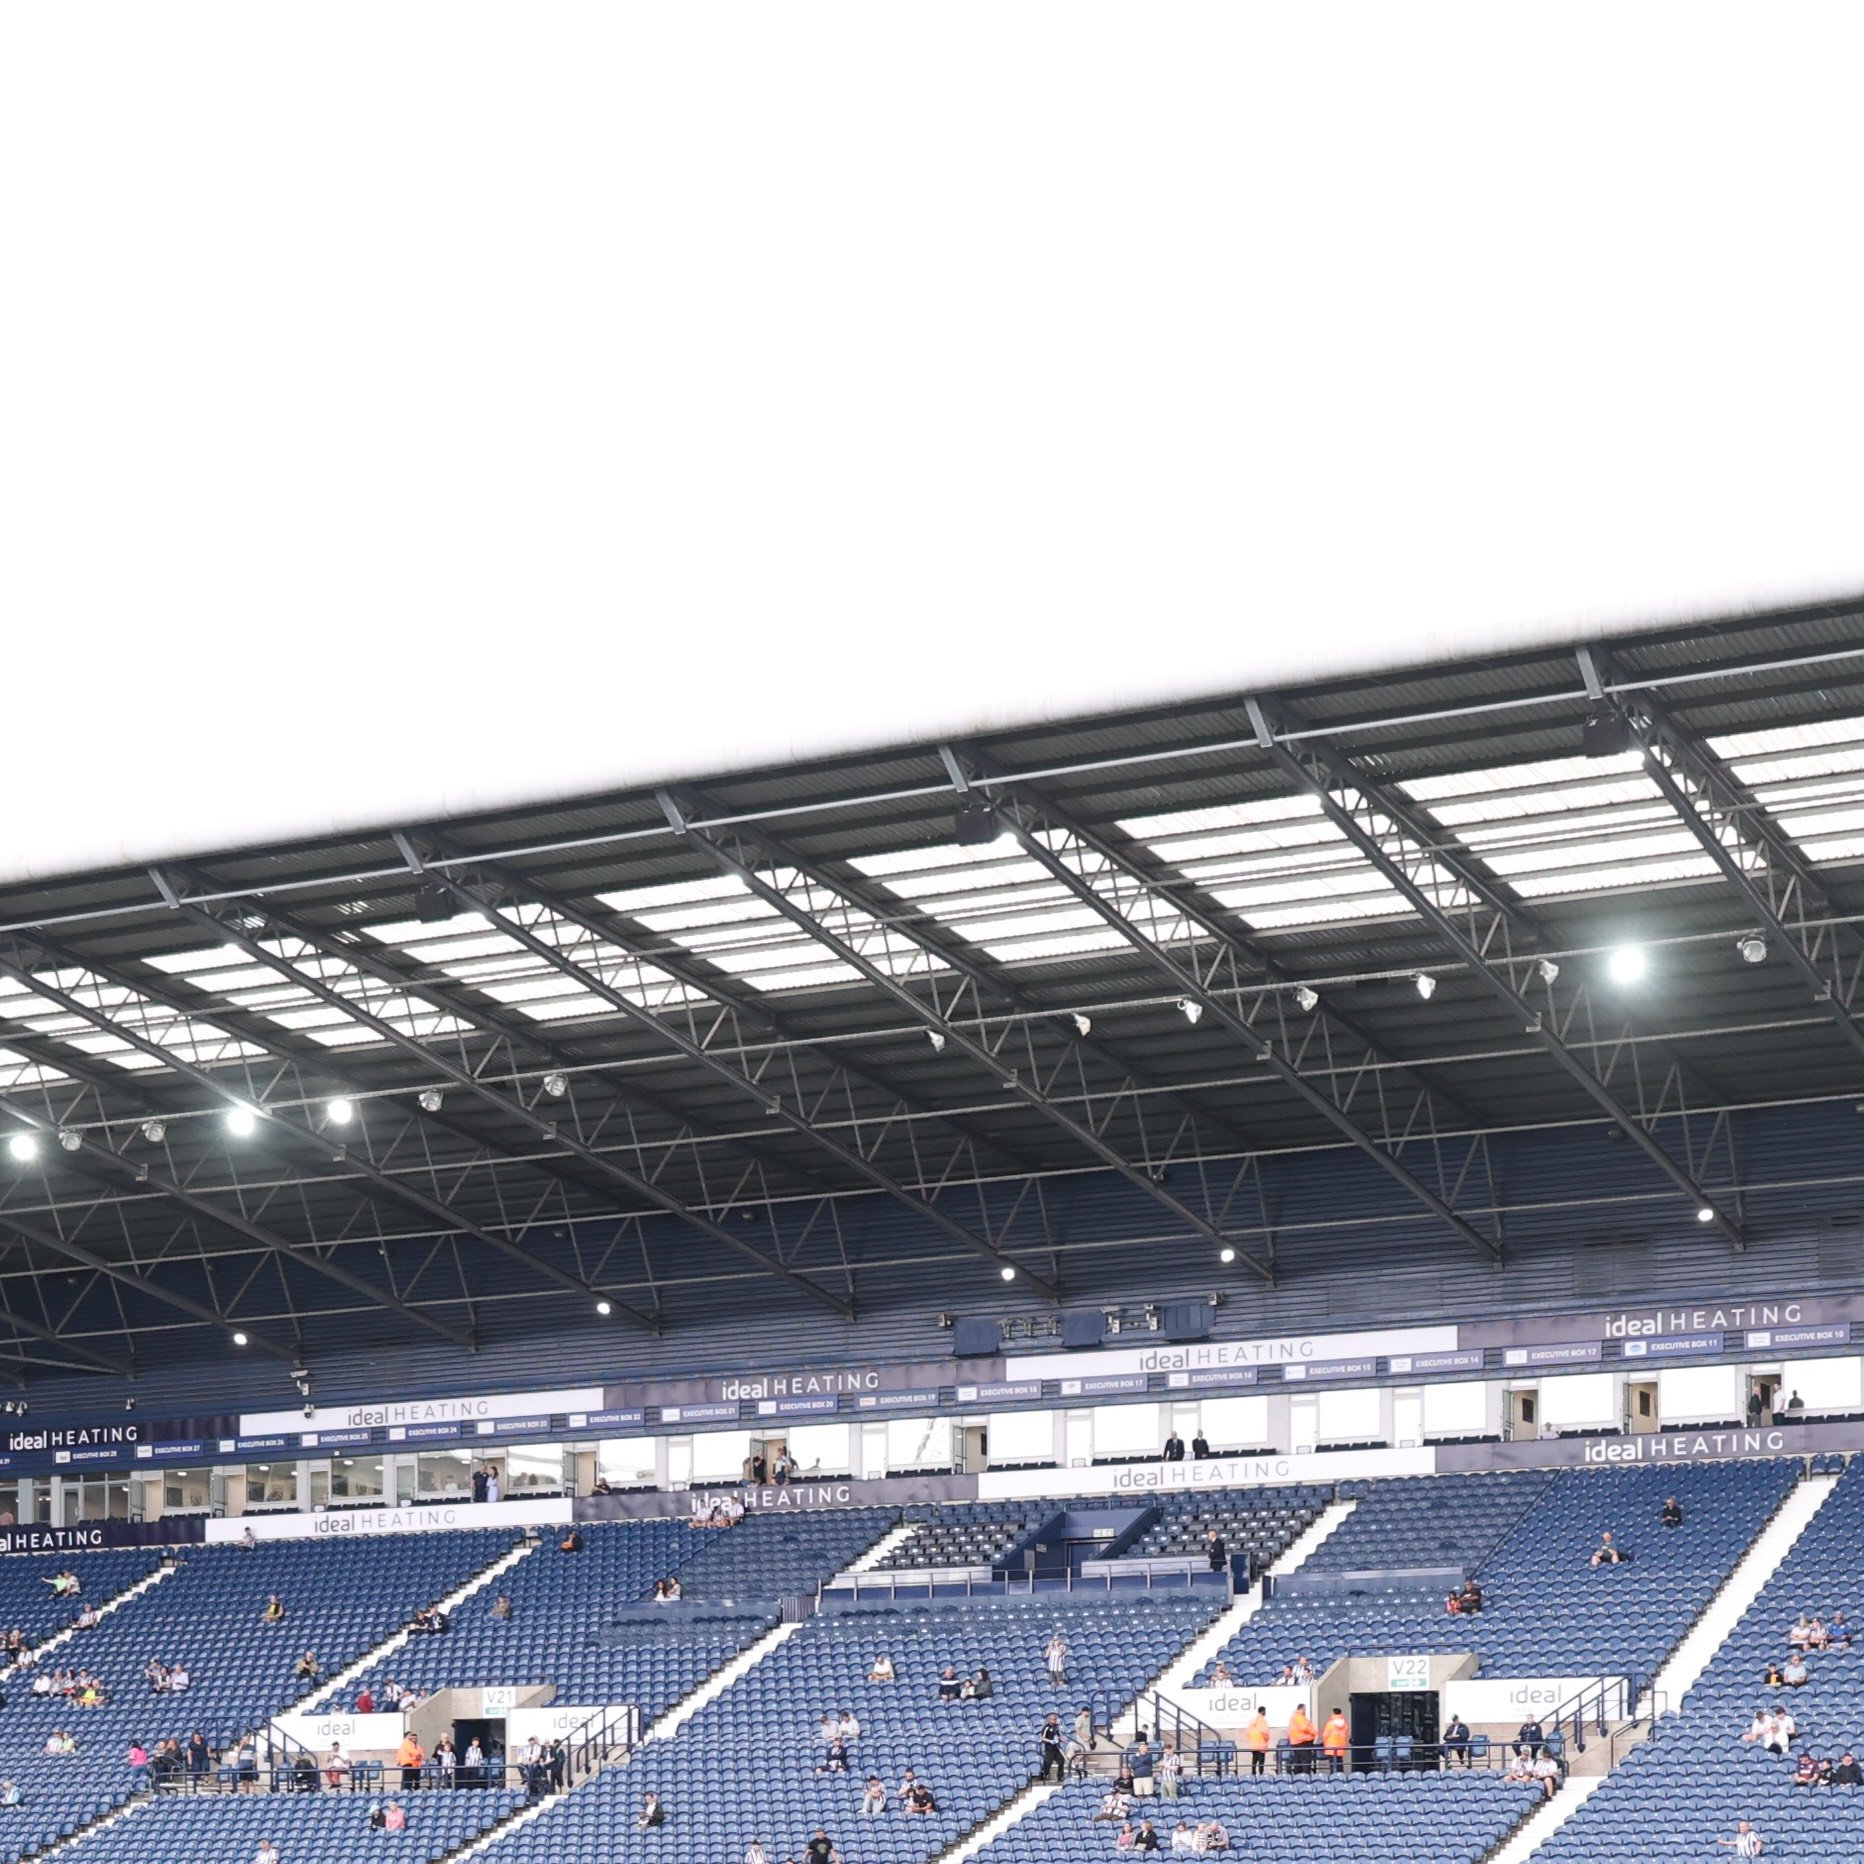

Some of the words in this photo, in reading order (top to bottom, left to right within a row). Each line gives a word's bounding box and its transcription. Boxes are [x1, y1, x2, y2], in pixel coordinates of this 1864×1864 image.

[1605, 1312, 1662, 1337] ideal
[1671, 1305, 1801, 1330] HEATING
[1775, 1331, 1815, 1342] EXECUTIVE
[1816, 1330, 1833, 1340] BOX
[1651, 1340, 1689, 1351] EXECUTIVE
[1691, 1339, 1707, 1348] BOX
[1139, 1348, 1189, 1370] ideal
[1197, 1341, 1313, 1365] HEATING
[1531, 1349, 1569, 1360] EXECUTIVE
[1570, 1348, 1586, 1357] BOX
[1347, 1363, 1361, 1372] BOX
[1416, 1357, 1452, 1368] EXECUTIVE
[1454, 1356, 1469, 1365] BOX
[1228, 1371, 1242, 1379] BOX
[722, 1378, 767, 1400] ideal
[775, 1372, 879, 1394] HEATING
[1014, 1386, 1028, 1394] BOX
[1120, 1379, 1133, 1387] BOX
[811, 1401, 825, 1409] BOX
[913, 1393, 926, 1402] BOX
[348, 1408, 388, 1426] ideal
[394, 1401, 488, 1420] HEATING
[620, 1413, 632, 1421] BOX
[714, 1407, 727, 1415] BOX
[10, 1431, 47, 1450] ideal
[52, 1426, 137, 1446] HEATING
[1584, 1437, 1642, 1462] ideal
[1651, 1431, 1783, 1456] HEATING
[1114, 1466, 1163, 1489] ideal
[1172, 1460, 1289, 1482] HEATING
[691, 1490, 739, 1512] ideal
[745, 1486, 850, 1508] HEATING
[314, 1514, 354, 1533] ideal
[361, 1509, 456, 1529] HEATING
[16, 1529, 102, 1549] HEATING
[1393, 1660, 1427, 1675] V22
[487, 1690, 512, 1703] V21
[1510, 1684, 1561, 1703] ideal
[1209, 1693, 1257, 1711] ideal
[317, 1719, 355, 1735] ideal
